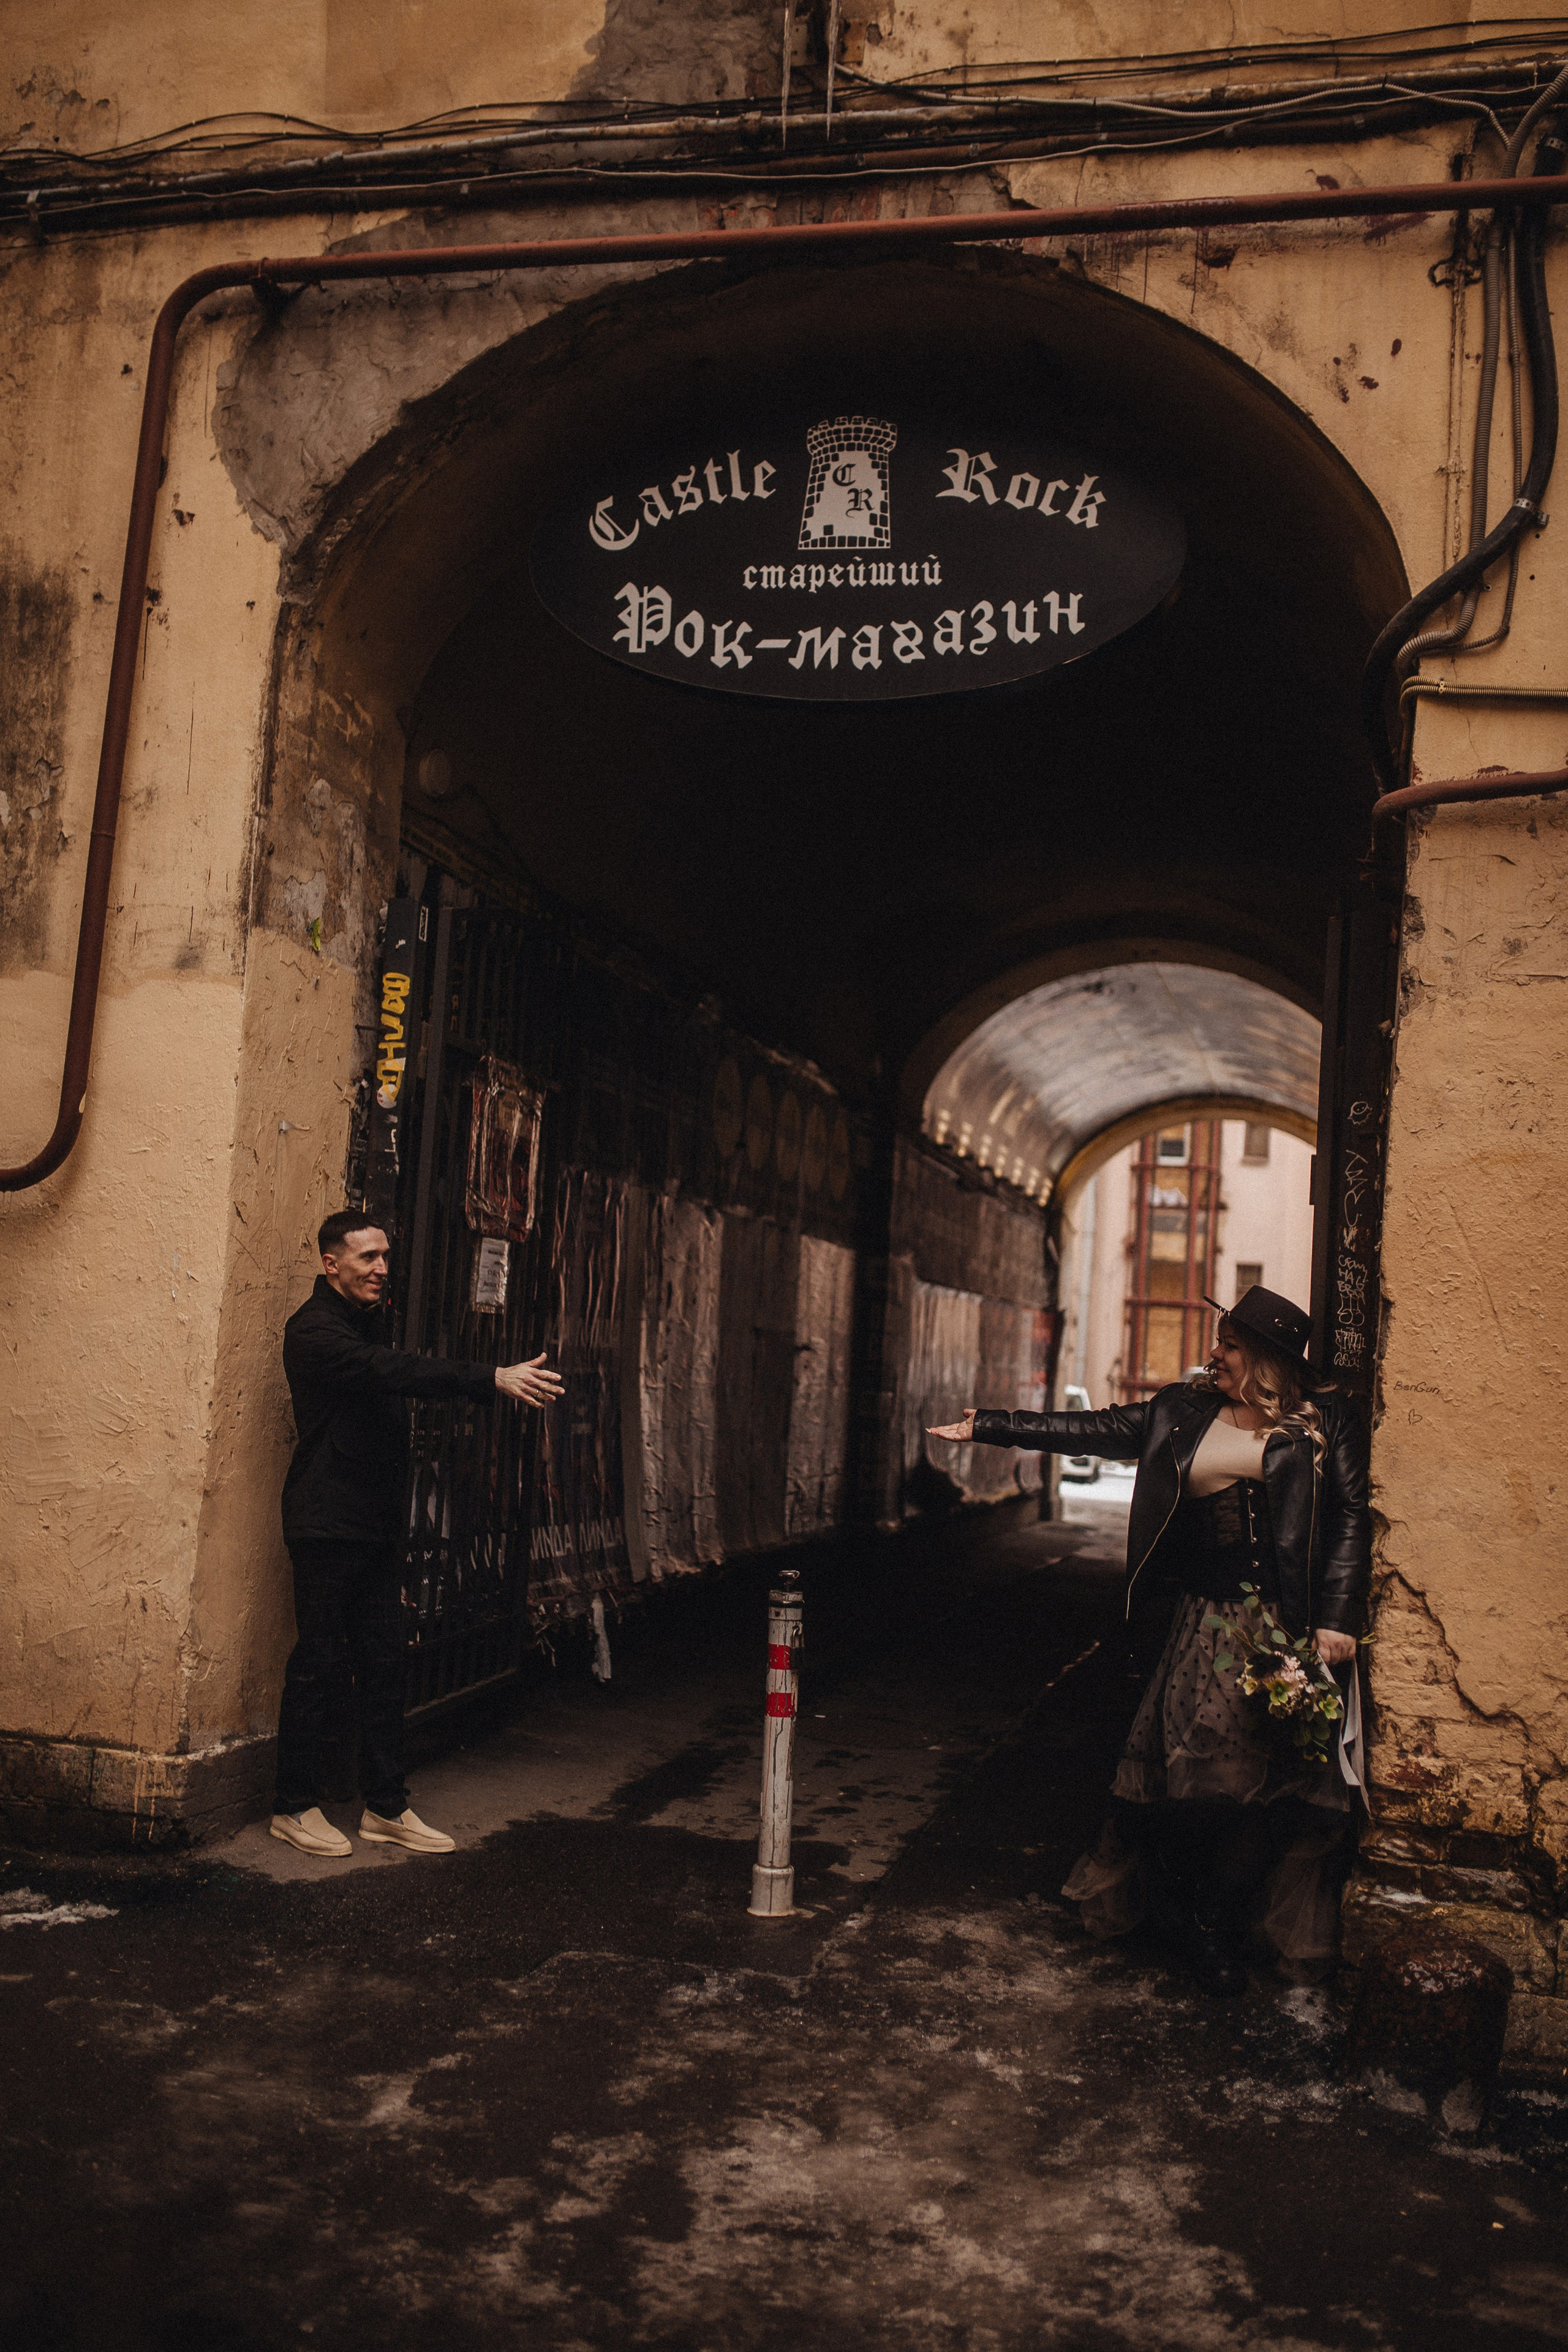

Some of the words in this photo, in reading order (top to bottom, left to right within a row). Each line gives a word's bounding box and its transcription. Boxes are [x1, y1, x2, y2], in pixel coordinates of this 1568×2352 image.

[589, 450, 776, 550] Castle
[936, 448, 1106, 529] Rock
[743, 554, 942, 594] старейший
[612, 582, 1086, 671] Рок-магазин
[1393, 1381, 1440, 1395] BenGun
